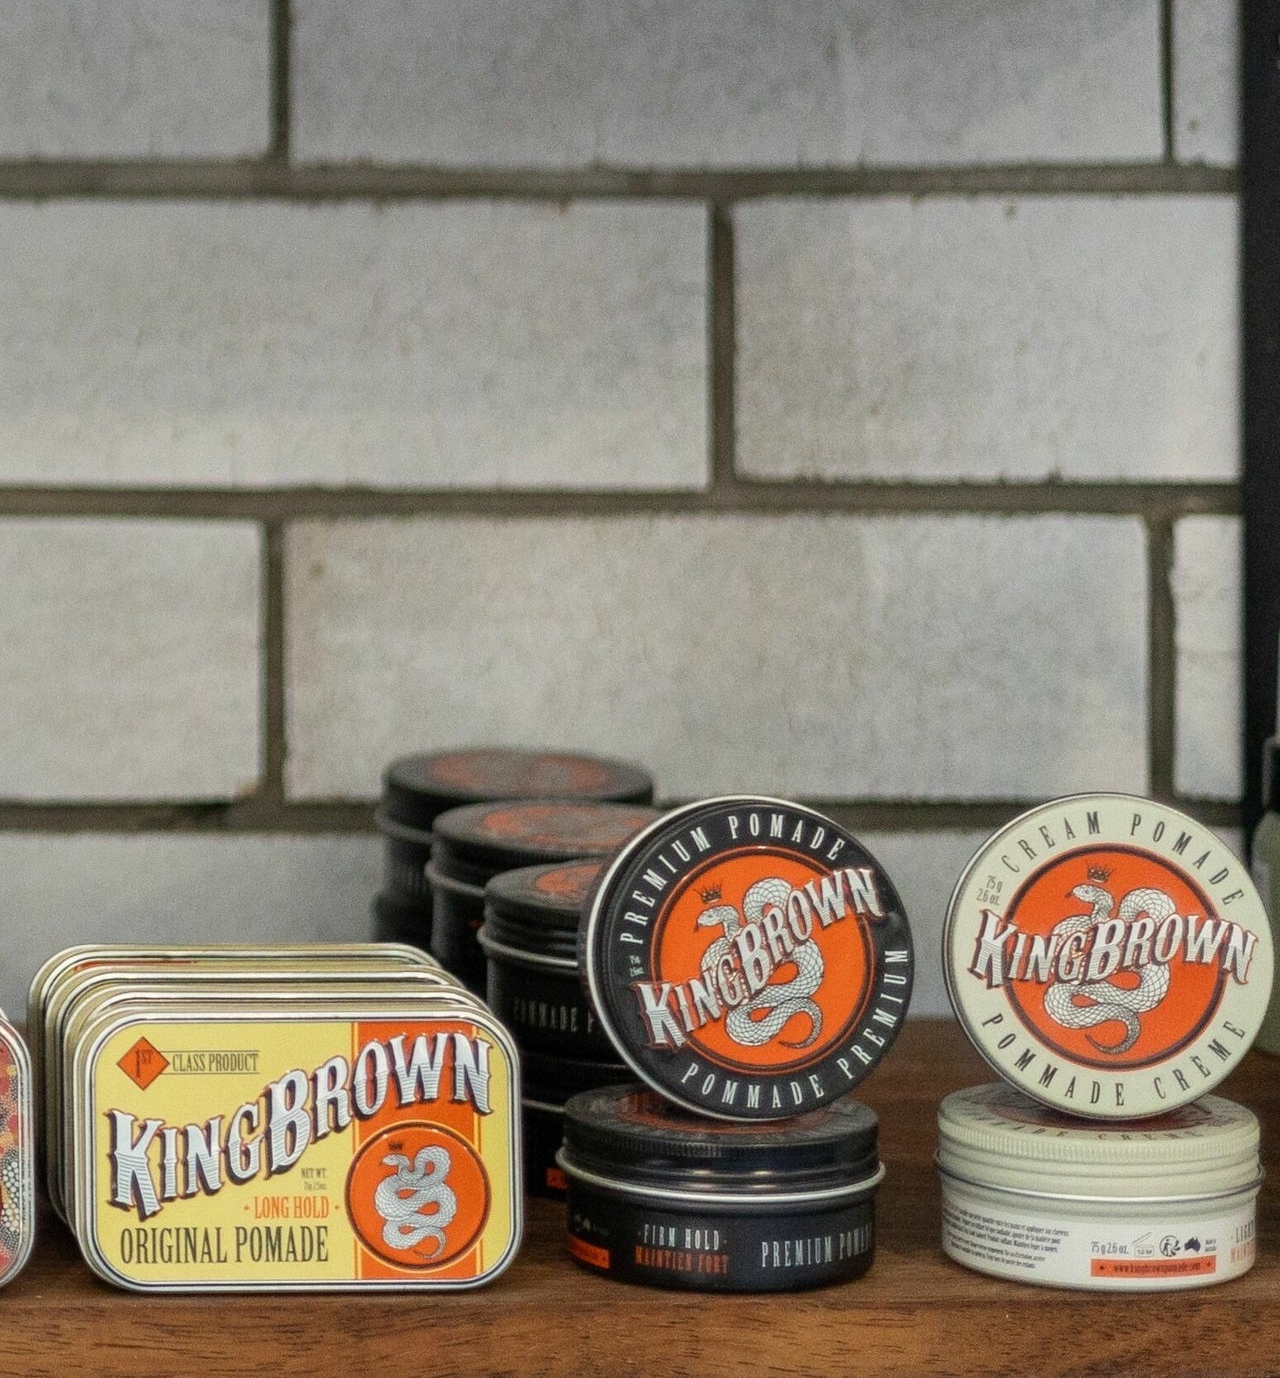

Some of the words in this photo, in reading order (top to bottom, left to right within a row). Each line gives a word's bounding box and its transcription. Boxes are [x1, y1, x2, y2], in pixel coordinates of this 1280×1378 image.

[621, 827, 711, 946] PREMIUM
[728, 812, 844, 861] POMADE
[1002, 811, 1101, 874] CREAM
[1130, 813, 1246, 907] POMADE
[680, 1061, 824, 1109] POMMADE
[837, 948, 909, 1080] PREMIUM
[981, 1012, 1126, 1106] POMMADE
[1153, 1020, 1246, 1100] CRÈME
[120, 1226, 228, 1263] ORIGINAL
[235, 1226, 328, 1262] POMADE
[254, 1197, 289, 1219] LONG
[294, 1197, 329, 1219] HOLD
[644, 1224, 676, 1247] FIRM
[685, 1228, 719, 1251] HOLD
